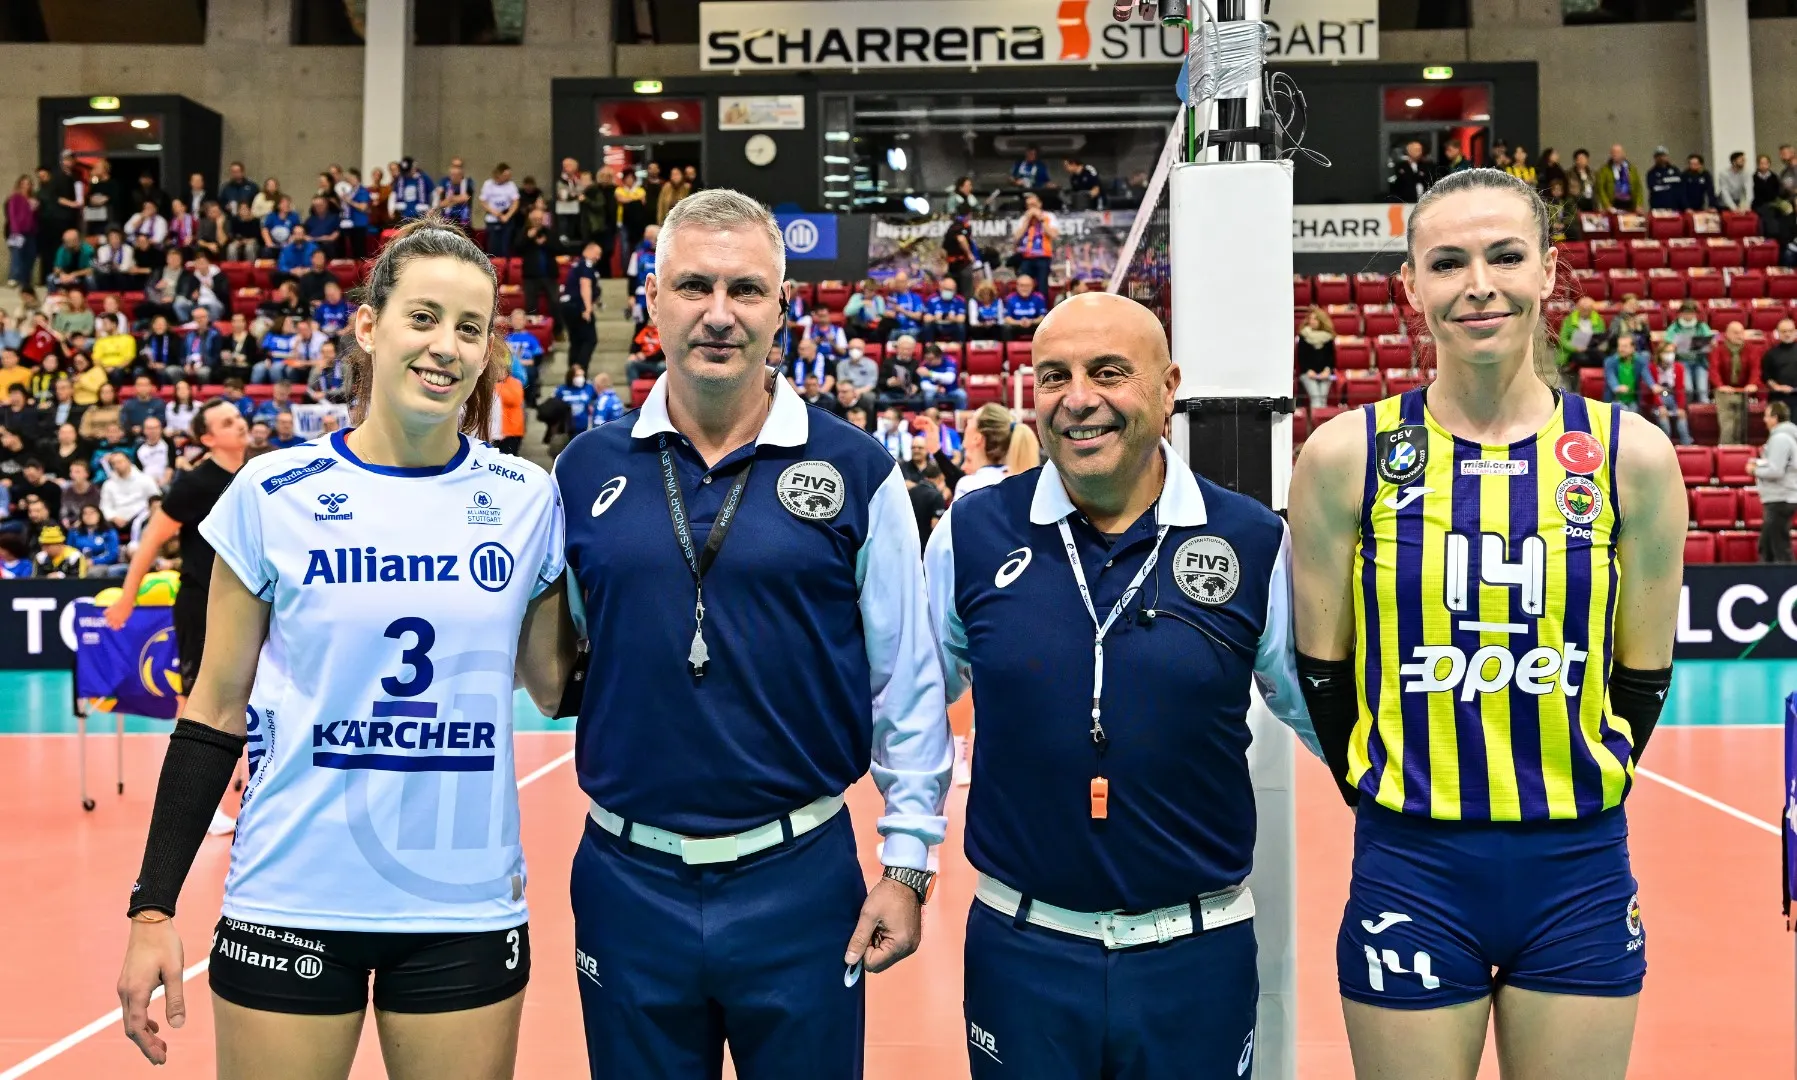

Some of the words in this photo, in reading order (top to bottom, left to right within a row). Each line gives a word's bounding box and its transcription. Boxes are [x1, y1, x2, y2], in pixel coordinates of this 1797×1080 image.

[1293, 218, 1381, 238] HARR
[1390, 429, 1413, 443] CEV
[270, 458, 328, 488] Sparda-Bank
[488, 463, 526, 484] DEKRA
[1463, 460, 1516, 470] misli.com
[792, 472, 837, 494] FIVB
[1579, 478, 1596, 492] SPOR
[314, 511, 353, 522] hummel
[467, 515, 502, 523] STUTTGART
[719, 484, 742, 528] #refscode
[671, 497, 698, 573] ALEKSANDAR
[302, 546, 460, 586] Allianz
[1186, 551, 1230, 573] FIVB
[1444, 532, 1546, 618] 14
[380, 616, 436, 698] 3
[1399, 642, 1589, 702] opet
[312, 719, 496, 750] KÄRCHER
[225, 918, 327, 953] Sparda-Bank
[505, 929, 520, 970] 3
[218, 937, 290, 972] Allianz
[576, 947, 598, 976] FIVB
[1363, 944, 1441, 992] 14
[971, 1021, 996, 1052] FIVB
